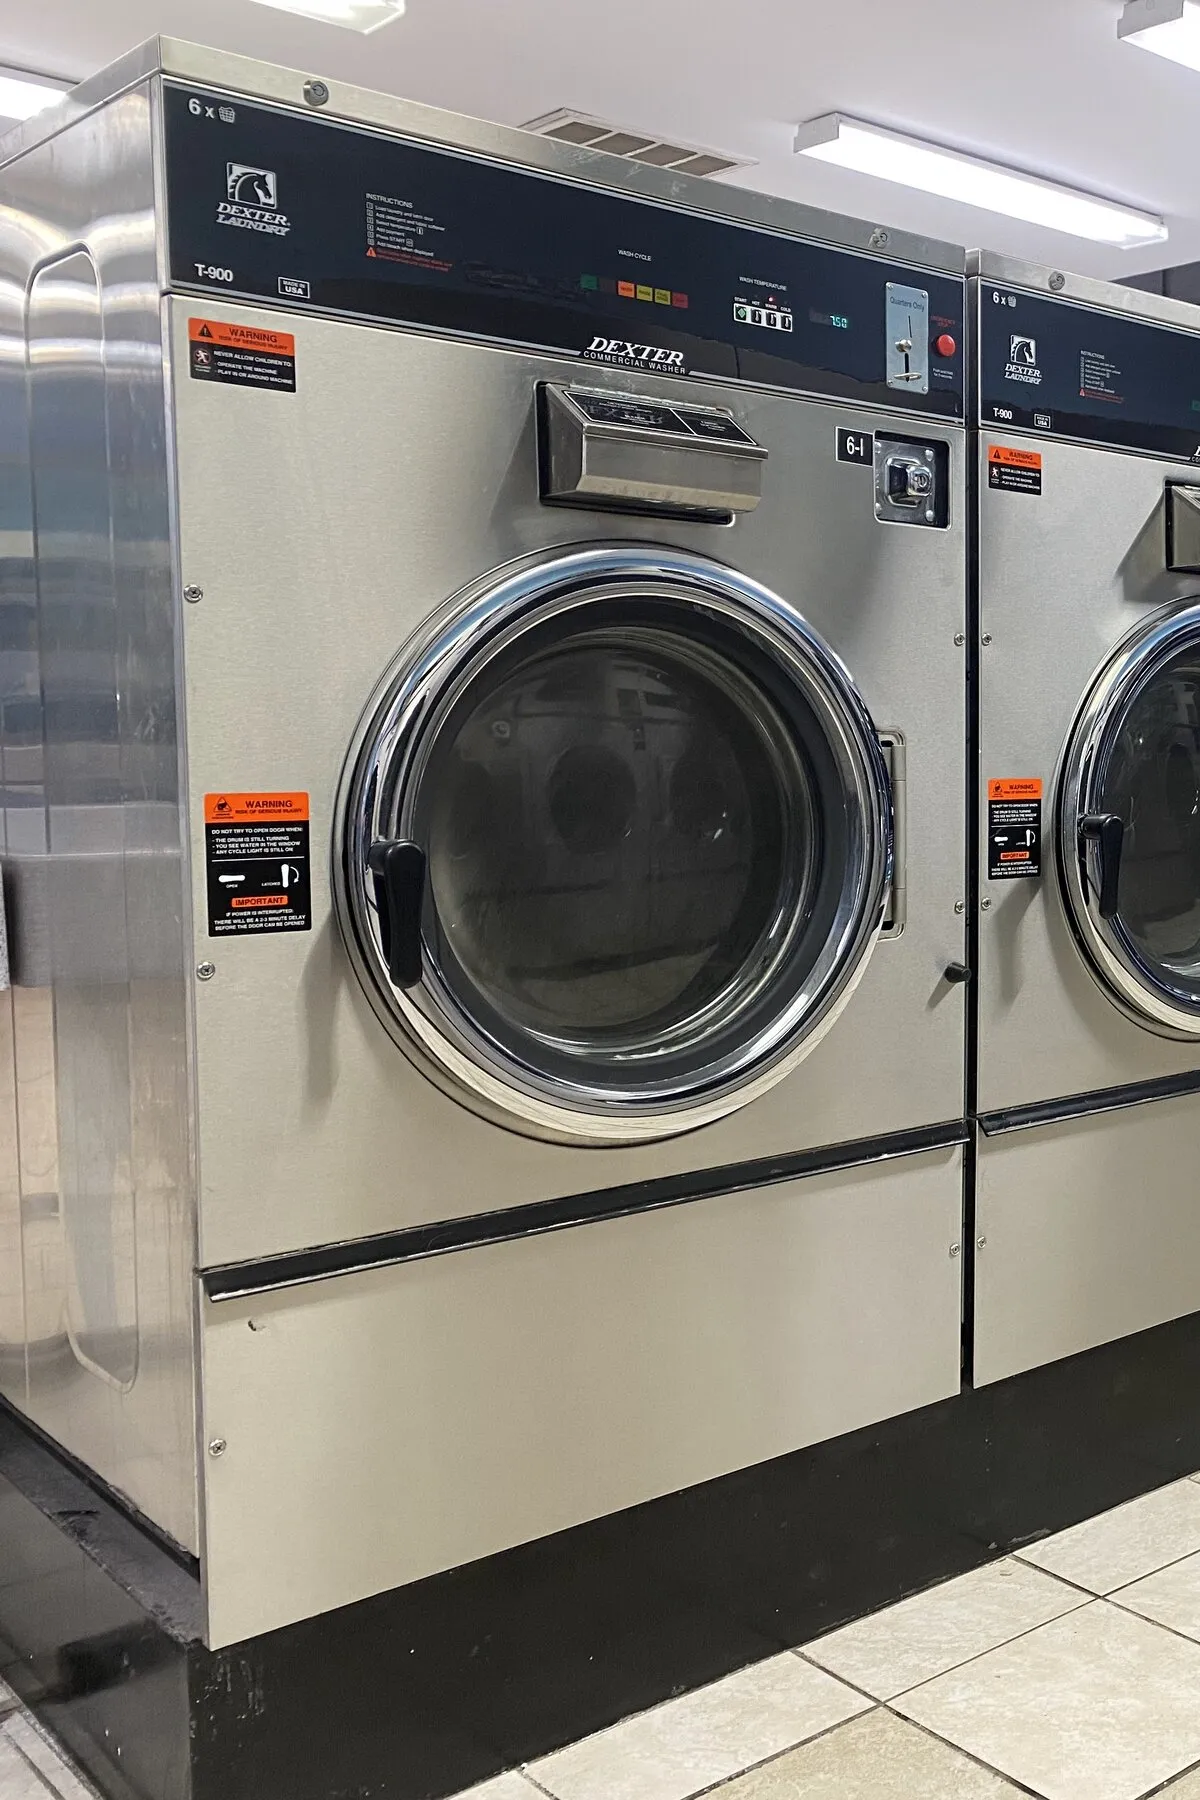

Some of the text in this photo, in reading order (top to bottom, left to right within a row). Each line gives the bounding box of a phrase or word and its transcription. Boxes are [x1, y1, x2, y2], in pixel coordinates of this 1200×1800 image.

[187, 97, 215, 120] 6 x
[366, 192, 413, 208] INSTRUCTIONS
[216, 202, 287, 226] DEXTER
[216, 213, 290, 236] LAUNDRY
[634, 253, 652, 261] CYCLE
[194, 263, 233, 283] T-900
[285, 286, 303, 295] USA
[754, 279, 787, 291] TEMPERATURE
[992, 291, 1006, 305] 6 x
[912, 301, 925, 312] Only
[229, 327, 278, 343] WARNING
[214, 350, 233, 359] NEVER
[234, 353, 254, 362] ALLOW
[255, 356, 283, 366] CHILDREN
[586, 336, 684, 366] DEXTER
[583, 350, 686, 374] COMMERCIAL WASHER
[1004, 363, 1041, 377] DEXTER
[1004, 371, 1042, 385] LAUNDRY
[992, 407, 1013, 420] T-900
[245, 800, 293, 809] WARNING
[235, 896, 284, 906] IMPORTANT
